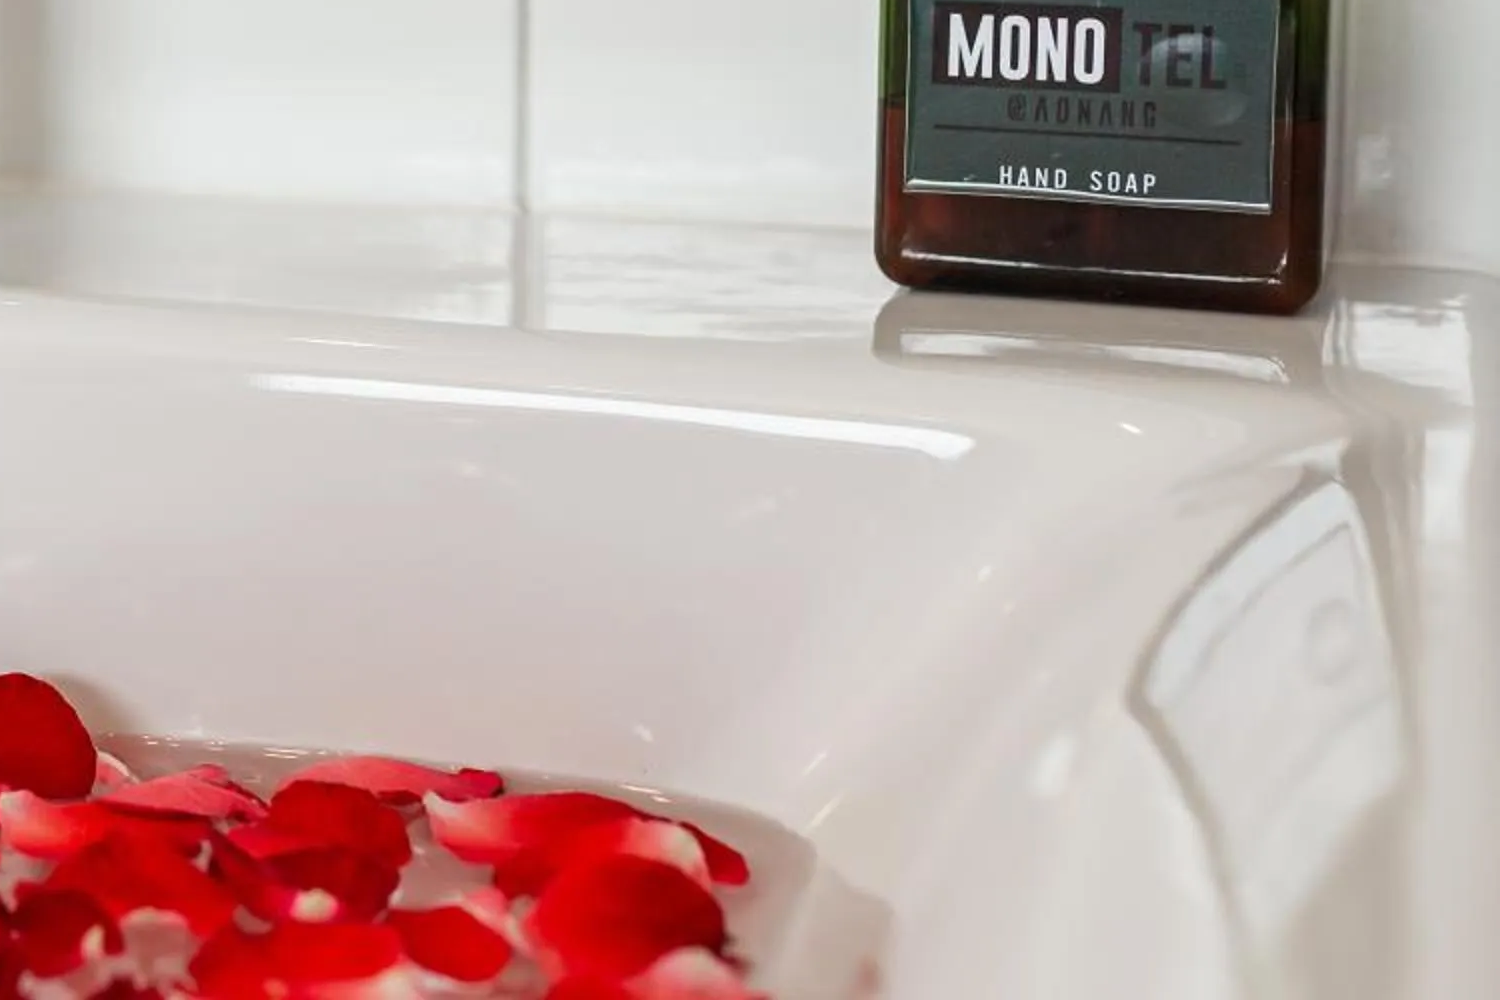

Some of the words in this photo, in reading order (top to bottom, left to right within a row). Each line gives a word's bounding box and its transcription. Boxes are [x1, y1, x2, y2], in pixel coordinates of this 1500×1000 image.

[946, 12, 1107, 86] MONO
[1132, 22, 1228, 91] TEL
[999, 164, 1068, 189] HAND
[1089, 169, 1157, 194] SOAP
